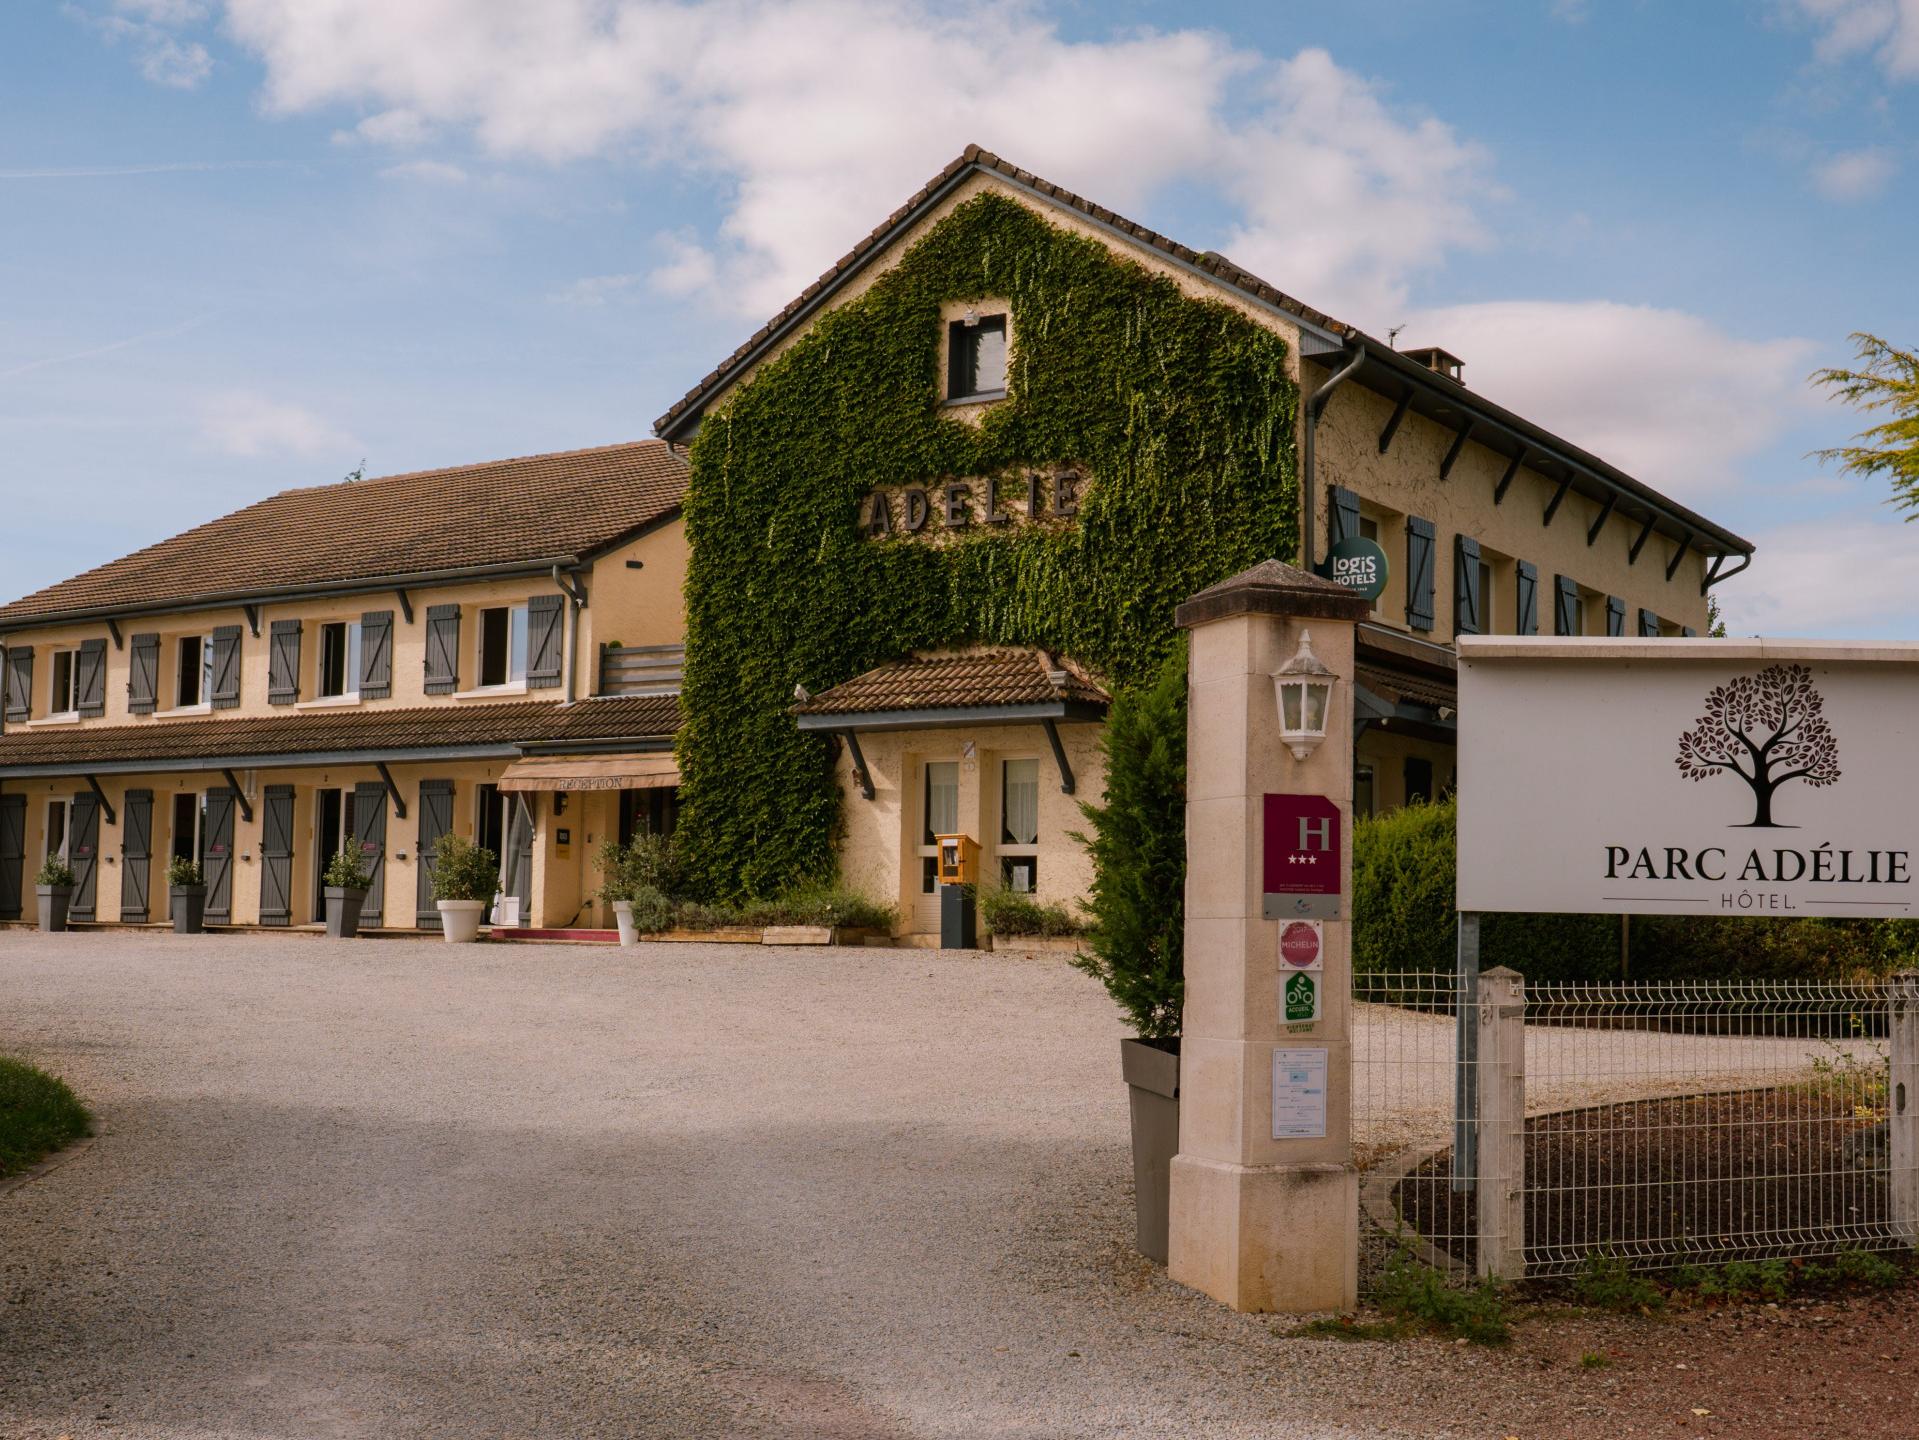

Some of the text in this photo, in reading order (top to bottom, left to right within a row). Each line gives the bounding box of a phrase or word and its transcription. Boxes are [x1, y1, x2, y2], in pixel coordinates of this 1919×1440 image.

[868, 471, 1078, 534] ADELIE
[1333, 573, 1376, 585] HOTELS
[1296, 816, 1336, 852] H
[1603, 841, 1912, 884] PARC ADÉLIE
[1721, 889, 1793, 909] HÔTEL
[1281, 940, 1319, 949] MICHELIN
